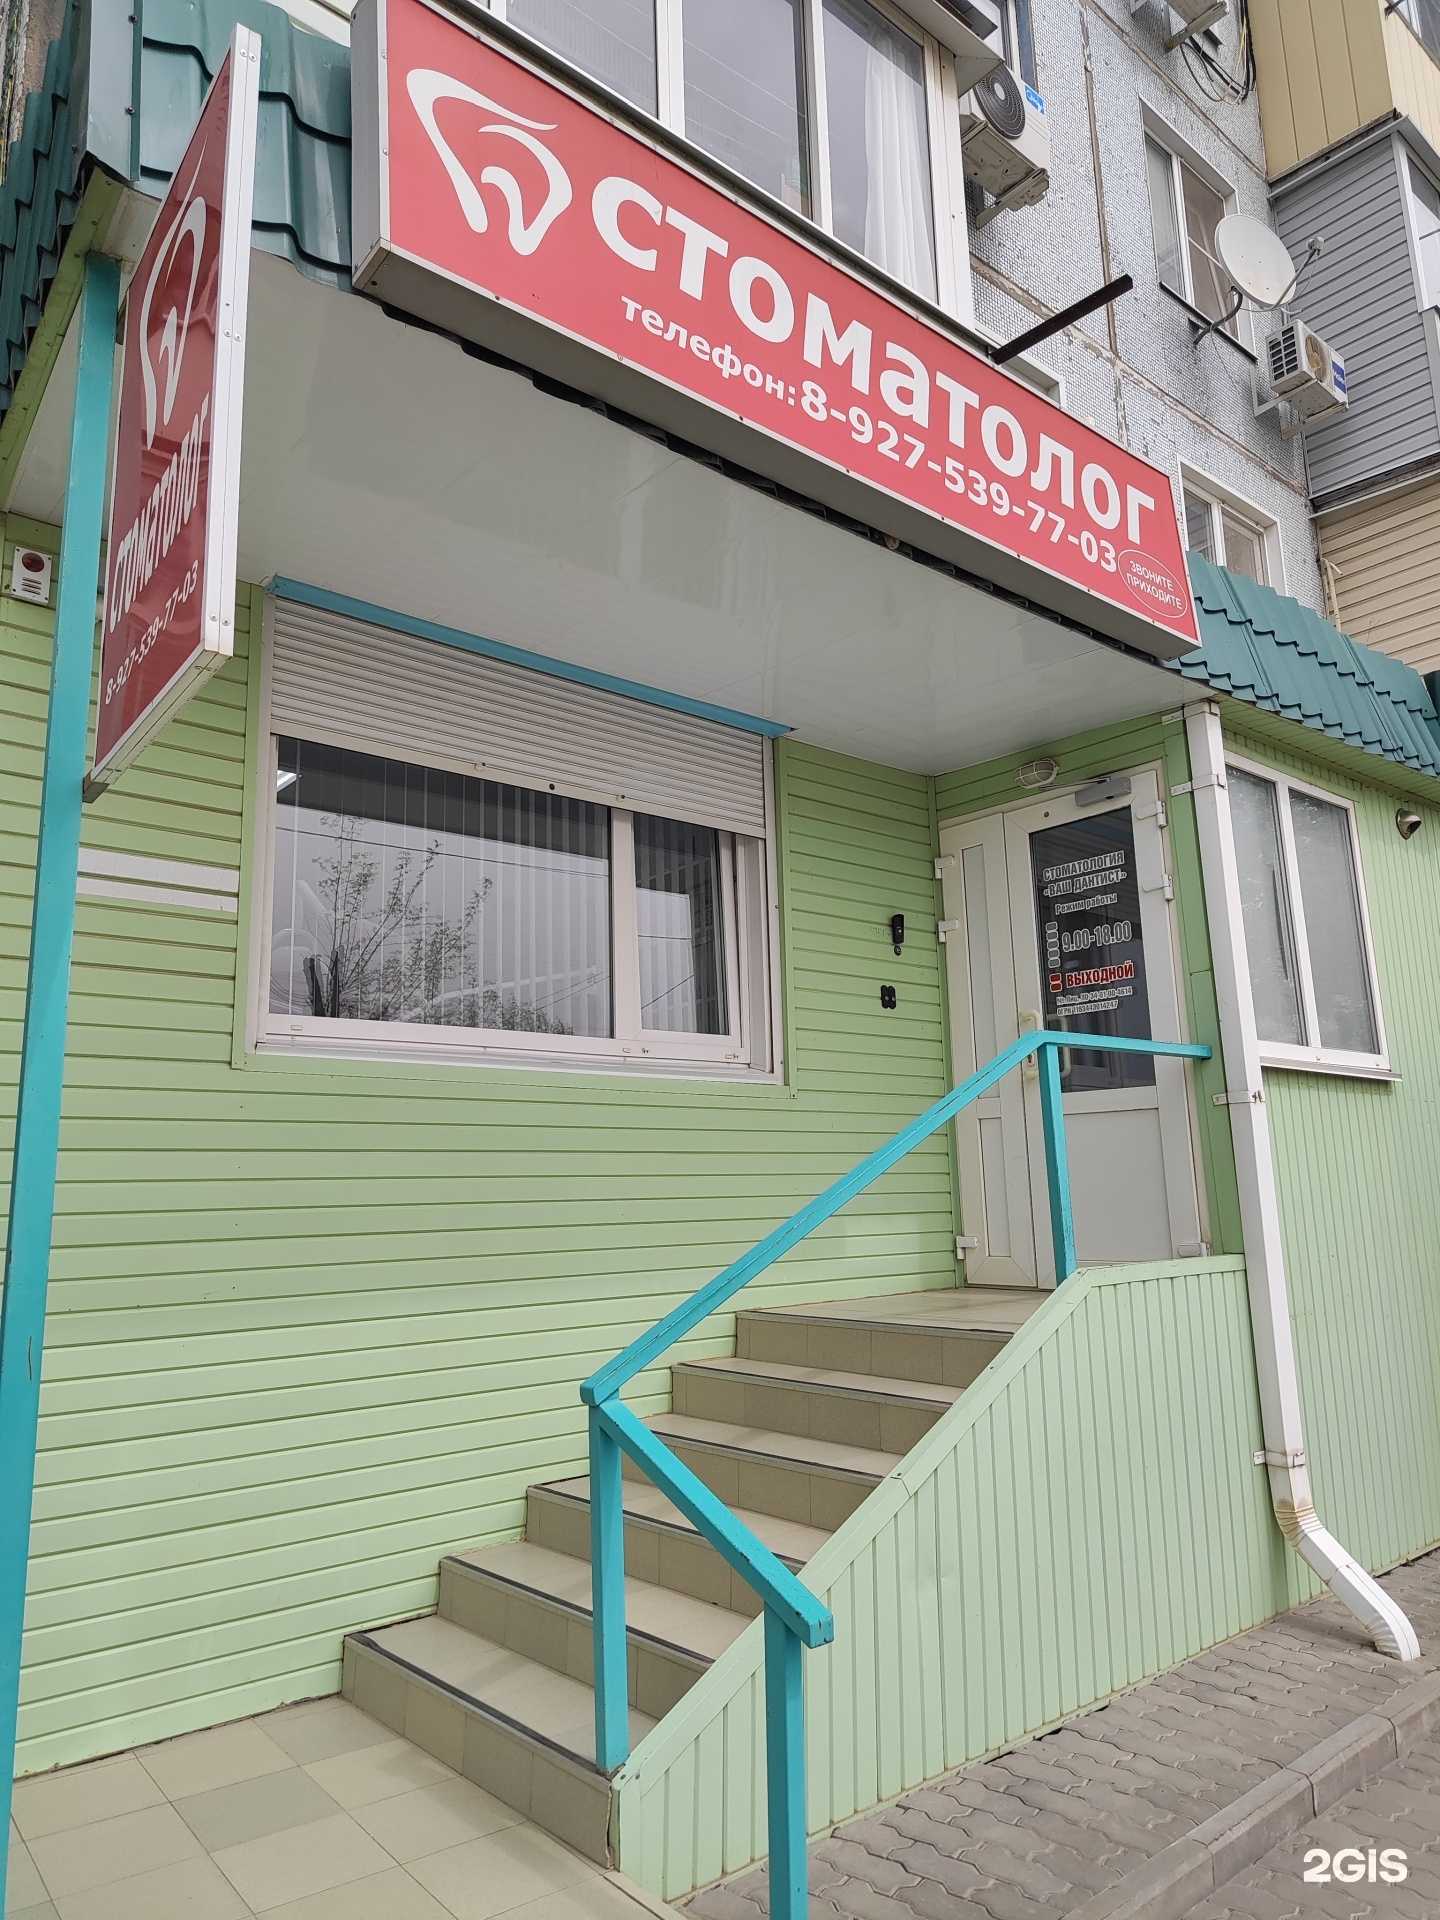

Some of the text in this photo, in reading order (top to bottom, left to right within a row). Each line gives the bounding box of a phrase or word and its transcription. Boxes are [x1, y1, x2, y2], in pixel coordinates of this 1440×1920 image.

[800, 380, 1117, 573] 8-927-539-77-03
[1126, 572, 1183, 610] ПРИХОДИТЕ
[1129, 560, 1174, 592] ЗВОНИТЕ
[104, 559, 200, 705] 8-927-539-77-03
[1043, 850, 1125, 881] СТОМАТОЛОГИЯ
[1055, 893, 1118, 915] Режим работы
[1062, 920, 1132, 952] 9.00-18.00
[1066, 960, 1135, 988] ВЫХОДНОЙ
